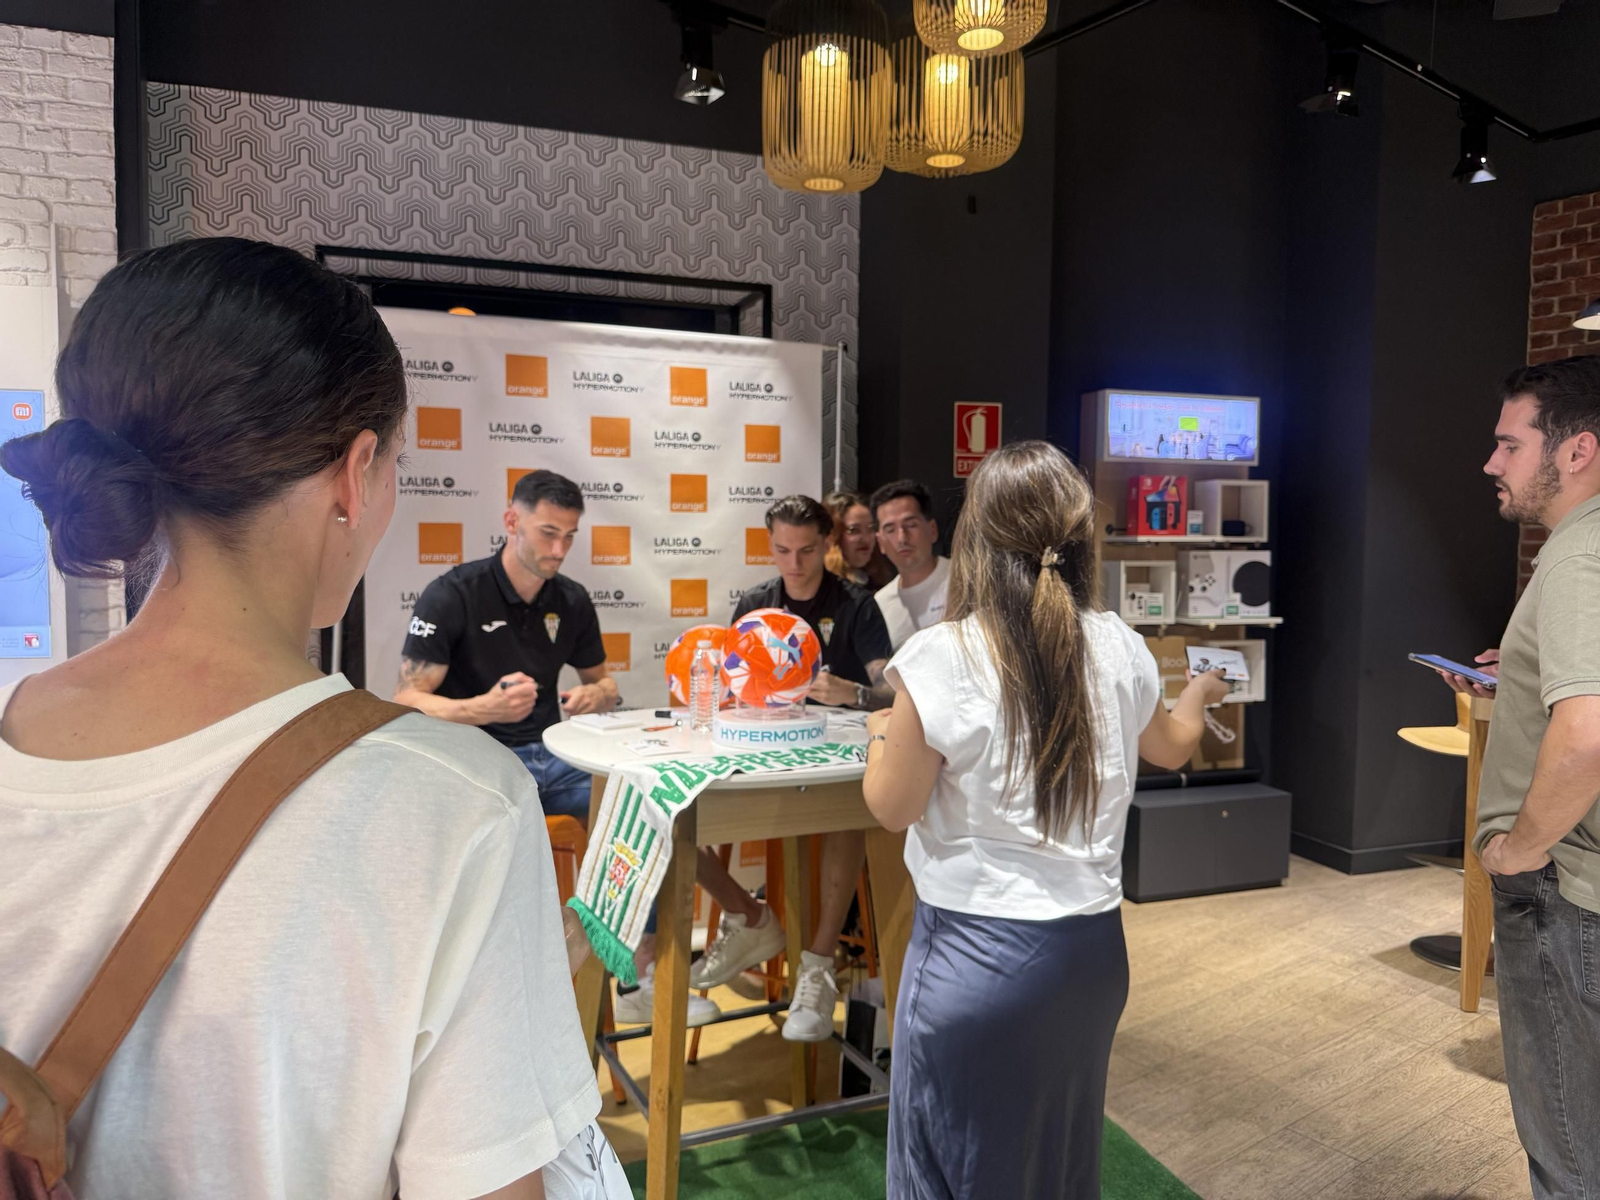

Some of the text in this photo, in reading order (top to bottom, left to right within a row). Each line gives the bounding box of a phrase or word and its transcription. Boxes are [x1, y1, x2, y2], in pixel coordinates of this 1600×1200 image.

[405, 360, 440, 371] ALIGA
[406, 372, 473, 383] YPERMOTION
[573, 371, 610, 382] LALIGA
[507, 386, 545, 397] orange
[573, 383, 639, 393] HYPERMOTION
[729, 382, 762, 392] LALIGA
[672, 395, 704, 406] orange
[729, 393, 787, 402] HYPERMOTION
[489, 422, 527, 434] LALIGA
[489, 434, 559, 444] HYPERMOTION
[655, 431, 689, 441] LALIGA
[419, 438, 457, 450] orange
[655, 442, 716, 451] HYPERMOTION
[592, 447, 627, 458] orange
[747, 453, 778, 463] orange
[400, 477, 440, 488] LALIGA
[580, 482, 611, 492] ALIGA
[400, 489, 474, 497] HYPERMOTION
[729, 486, 762, 496] LALIGA
[672, 502, 704, 512] orange
[655, 537, 689, 547] LALIGA
[655, 548, 716, 556] HYPERMOTION
[421, 554, 459, 565] orange
[593, 554, 627, 564] orange
[672, 606, 704, 617] orange
[720, 726, 824, 743] HYPERMOTION
